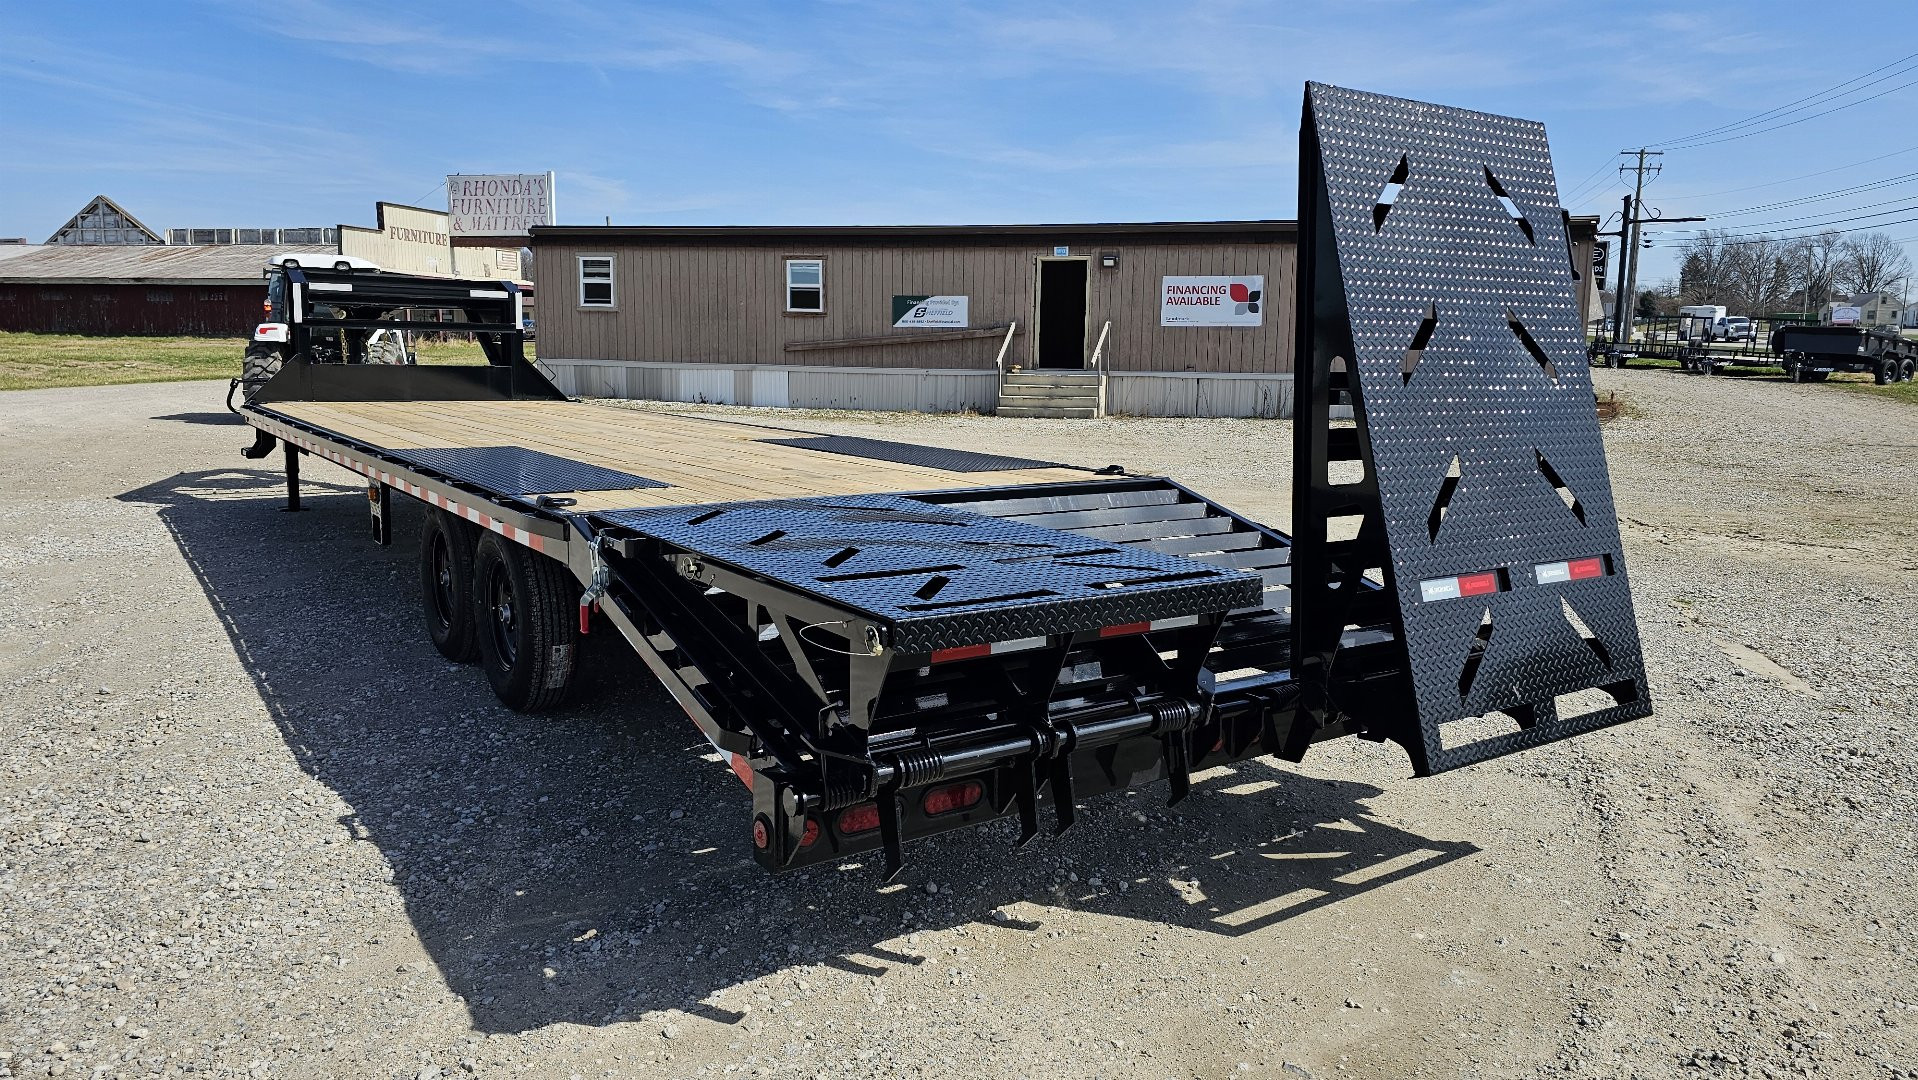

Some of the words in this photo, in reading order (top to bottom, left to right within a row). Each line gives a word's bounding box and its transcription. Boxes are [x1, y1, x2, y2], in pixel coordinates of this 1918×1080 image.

[463, 179, 545, 196] RHONDA'S
[451, 198, 547, 215] FURNITURE
[453, 217, 466, 233] &
[390, 226, 447, 246] FURNITURE
[1166, 285, 1227, 295] FINANCING
[1166, 296, 1221, 306] AVAILABLE
